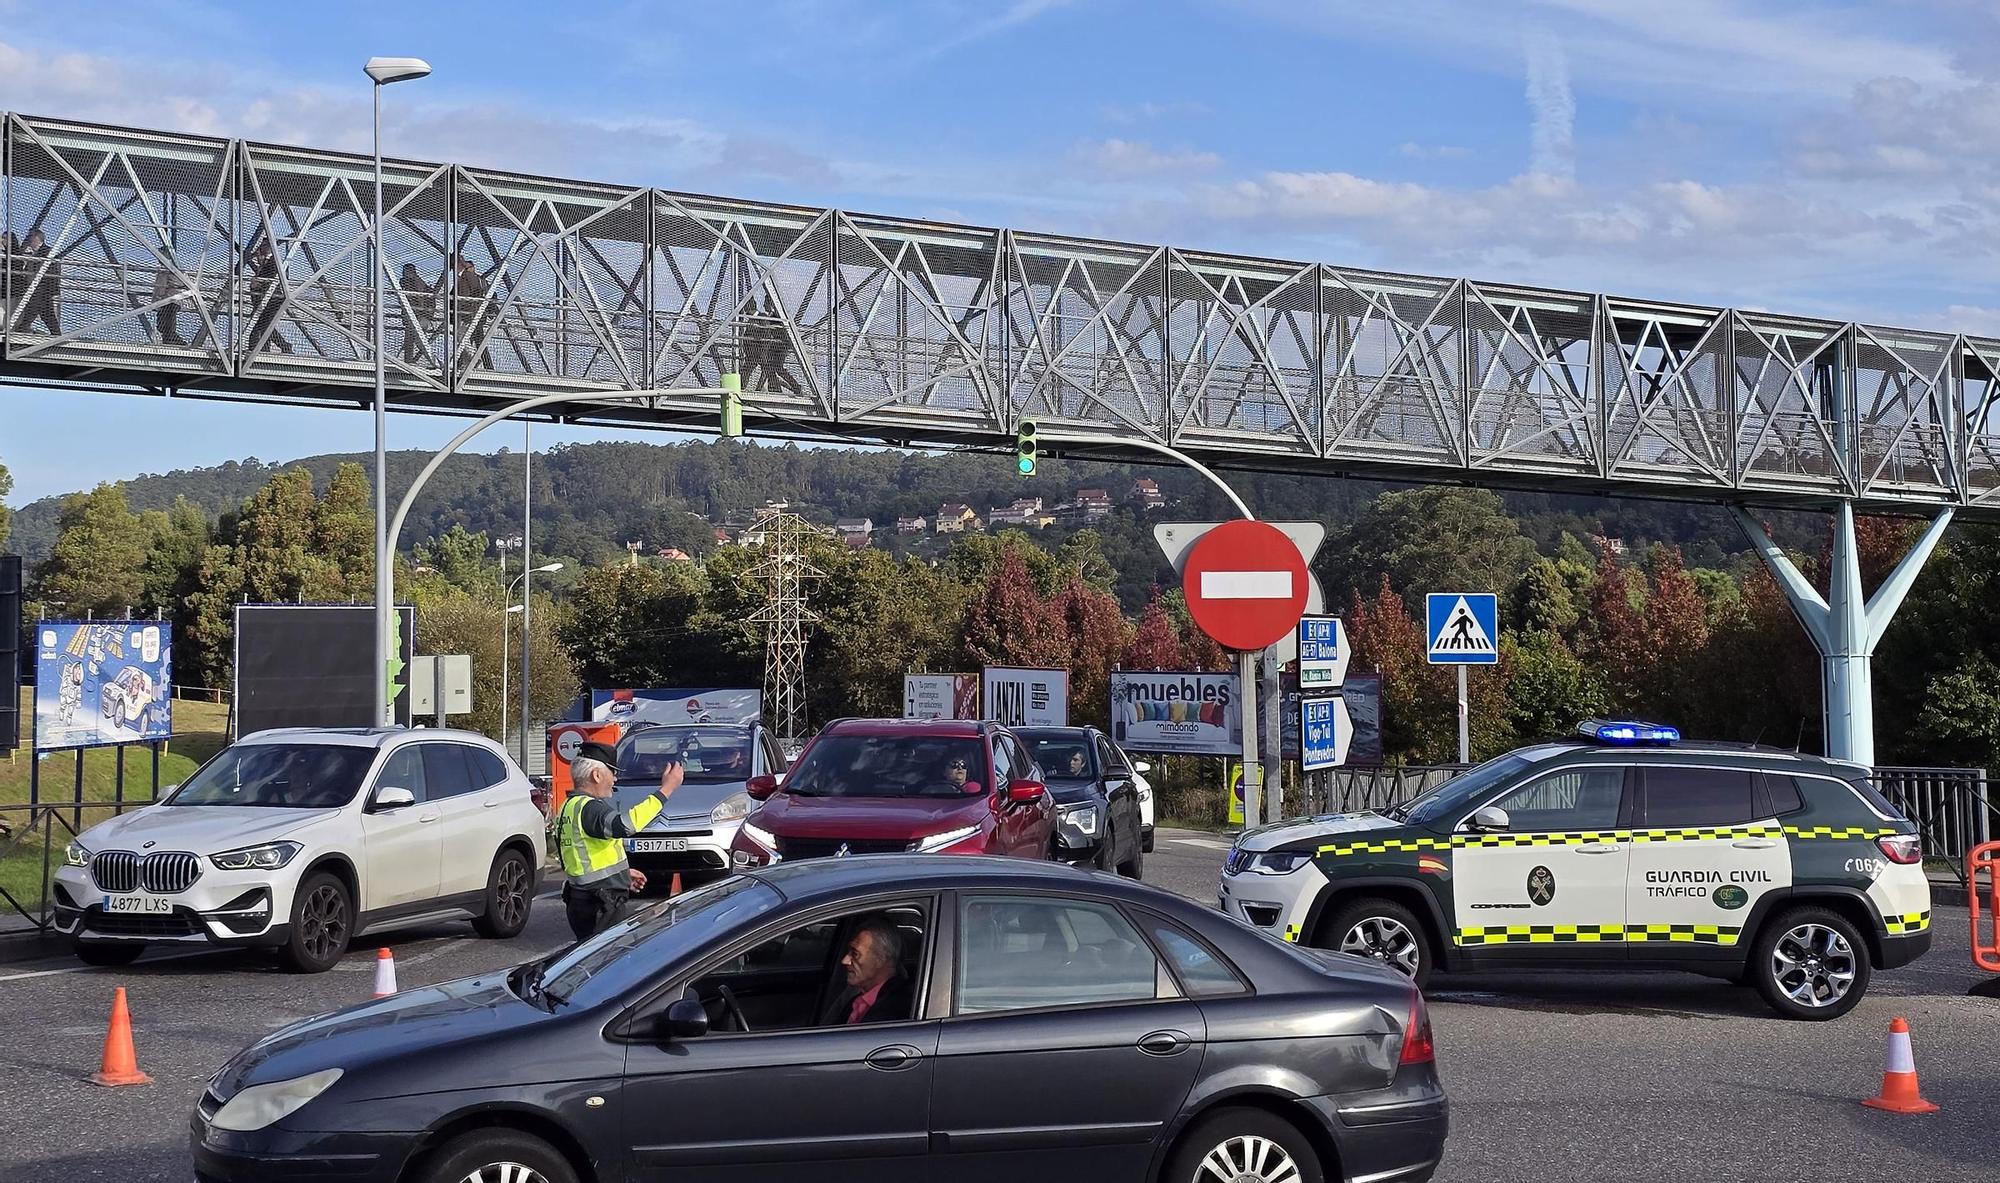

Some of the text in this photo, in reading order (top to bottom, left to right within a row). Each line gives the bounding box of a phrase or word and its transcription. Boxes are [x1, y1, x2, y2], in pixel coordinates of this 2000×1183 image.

[1318, 642, 1337, 658] Baiona
[1127, 677, 1230, 706] muebles
[1304, 744, 1335, 763] Pontevedra
[636, 840, 685, 851] 5917 FLS
[1855, 858, 1882, 872] 062
[1645, 870, 1772, 883] GUARDIA CIVIL
[1646, 884, 1707, 897] TRÁFICO
[111, 896, 169, 911] 4877 LXS
